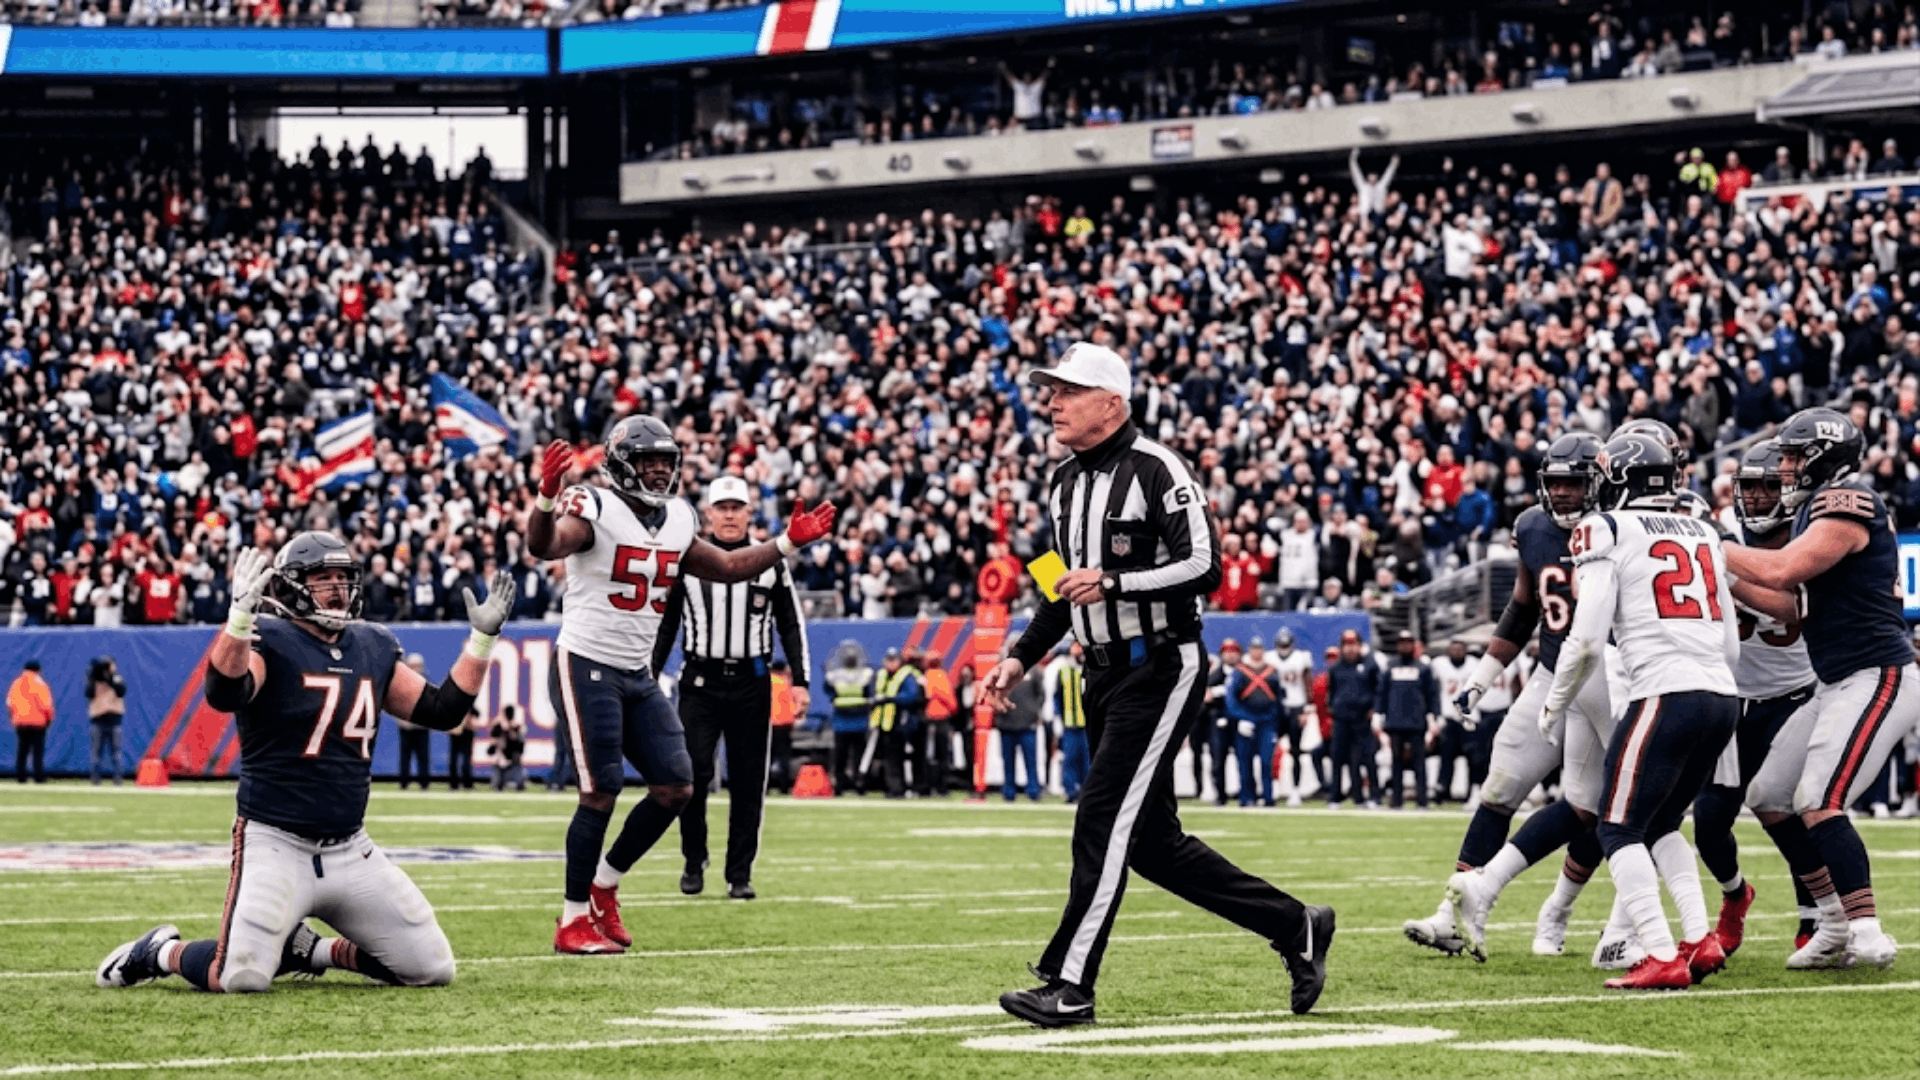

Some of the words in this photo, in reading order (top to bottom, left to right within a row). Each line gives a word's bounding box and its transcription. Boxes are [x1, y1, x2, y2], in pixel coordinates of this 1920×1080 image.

[886, 154, 912, 171] 40
[1572, 525, 1592, 557] 21
[607, 544, 681, 614] 55
[1648, 539, 1723, 620] 21
[302, 672, 377, 760] 74
